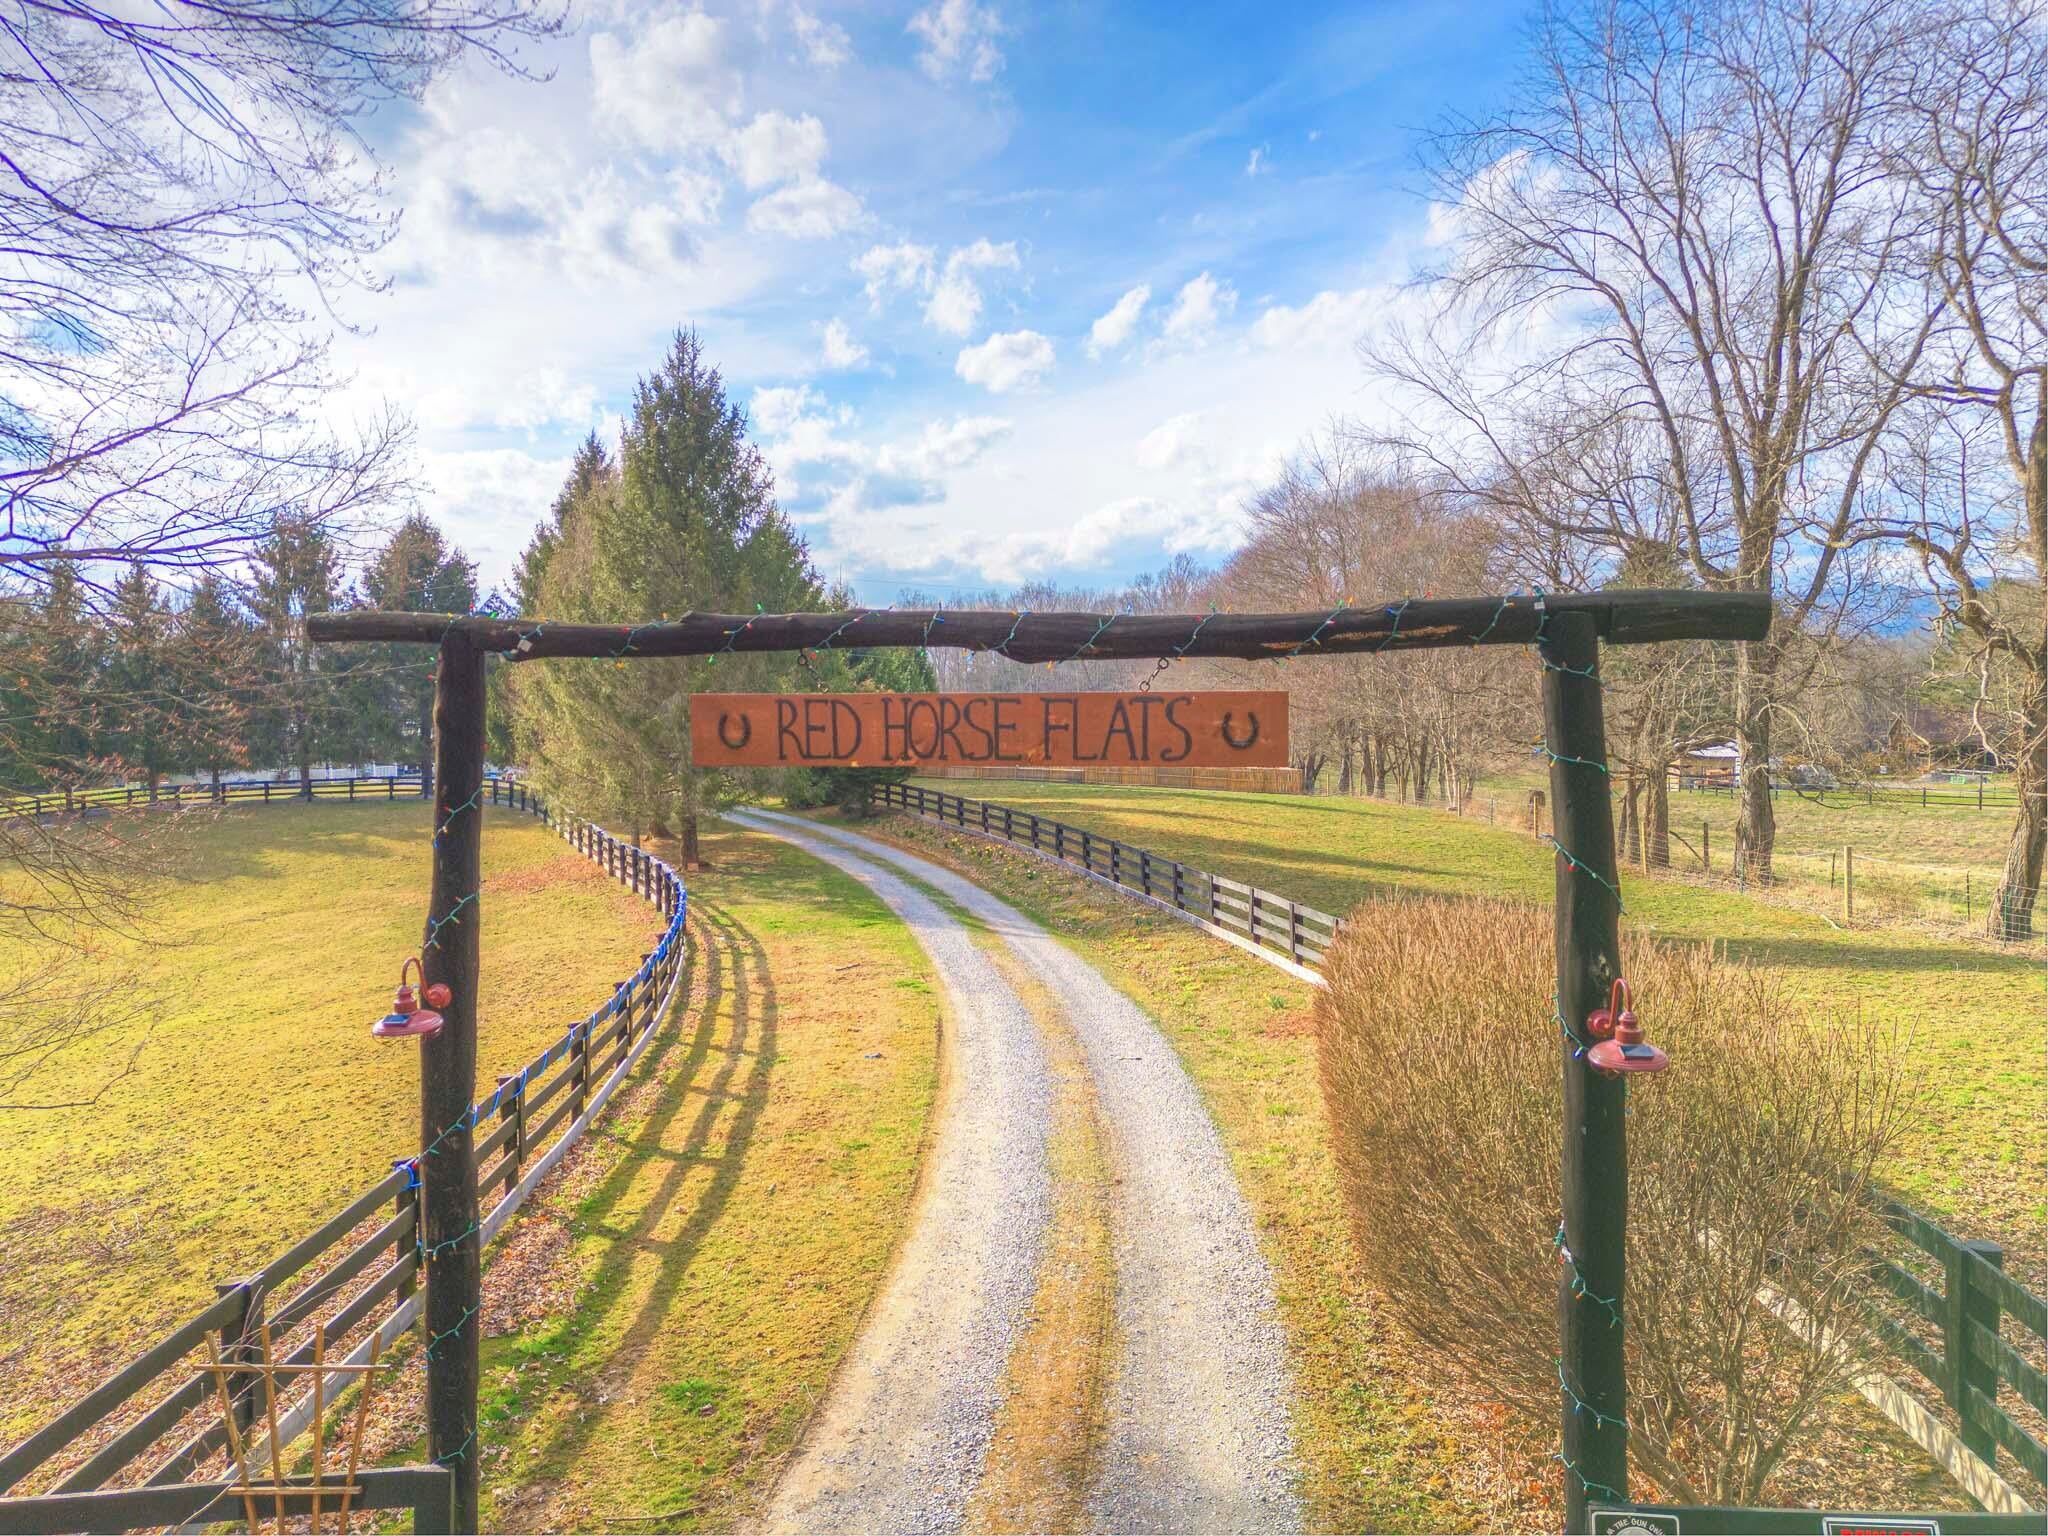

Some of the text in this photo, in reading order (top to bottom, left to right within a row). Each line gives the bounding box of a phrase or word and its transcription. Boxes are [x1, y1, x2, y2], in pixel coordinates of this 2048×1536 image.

[777, 696, 1194, 761] RED HORSE FLATS
